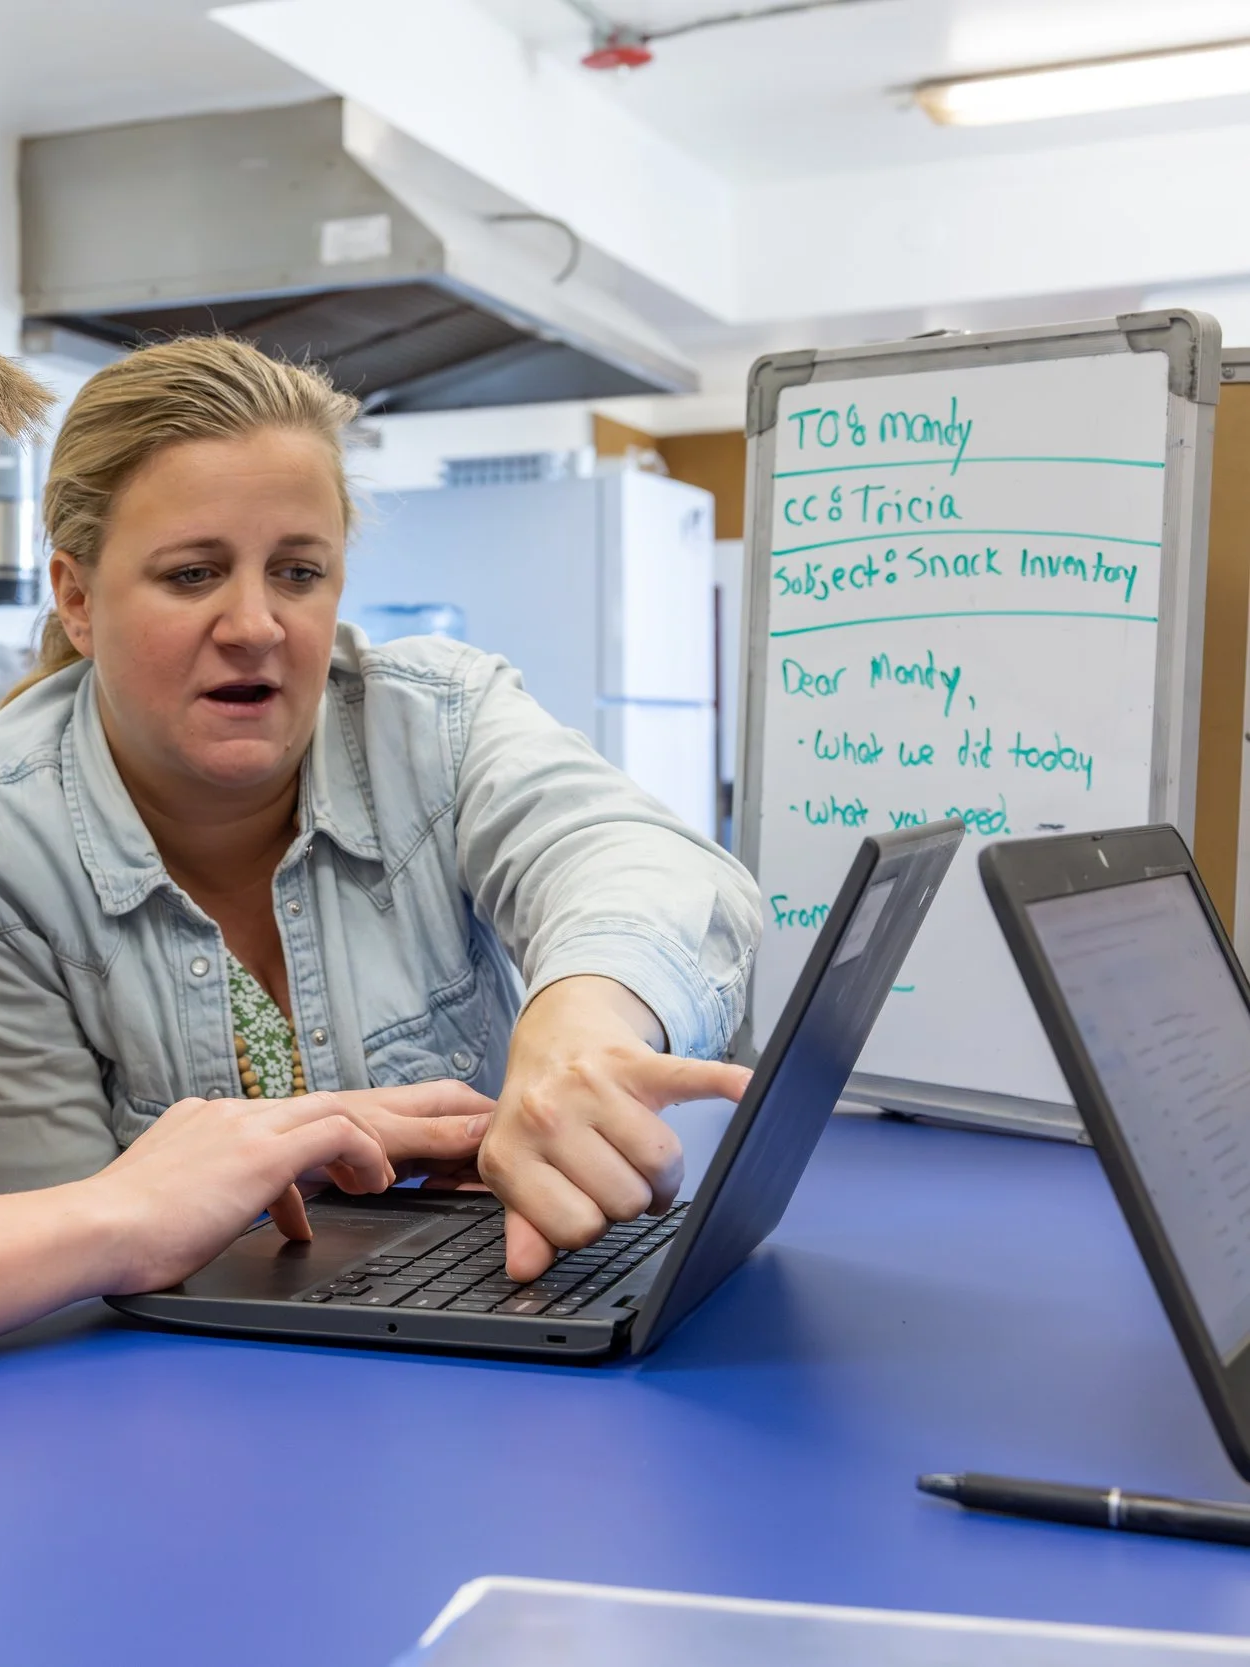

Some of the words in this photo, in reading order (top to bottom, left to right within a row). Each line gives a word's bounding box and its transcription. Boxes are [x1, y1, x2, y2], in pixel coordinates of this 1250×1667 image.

[788, 403, 866, 449] TO:
[851, 484, 963, 525] Tricia
[906, 547, 1002, 578] Snack
[1020, 548, 1138, 603] Inventory
[781, 657, 847, 698] Dear
[898, 741, 935, 768] we
[957, 727, 993, 769] did
[1007, 731, 1094, 790] today
[889, 808, 928, 831] you
